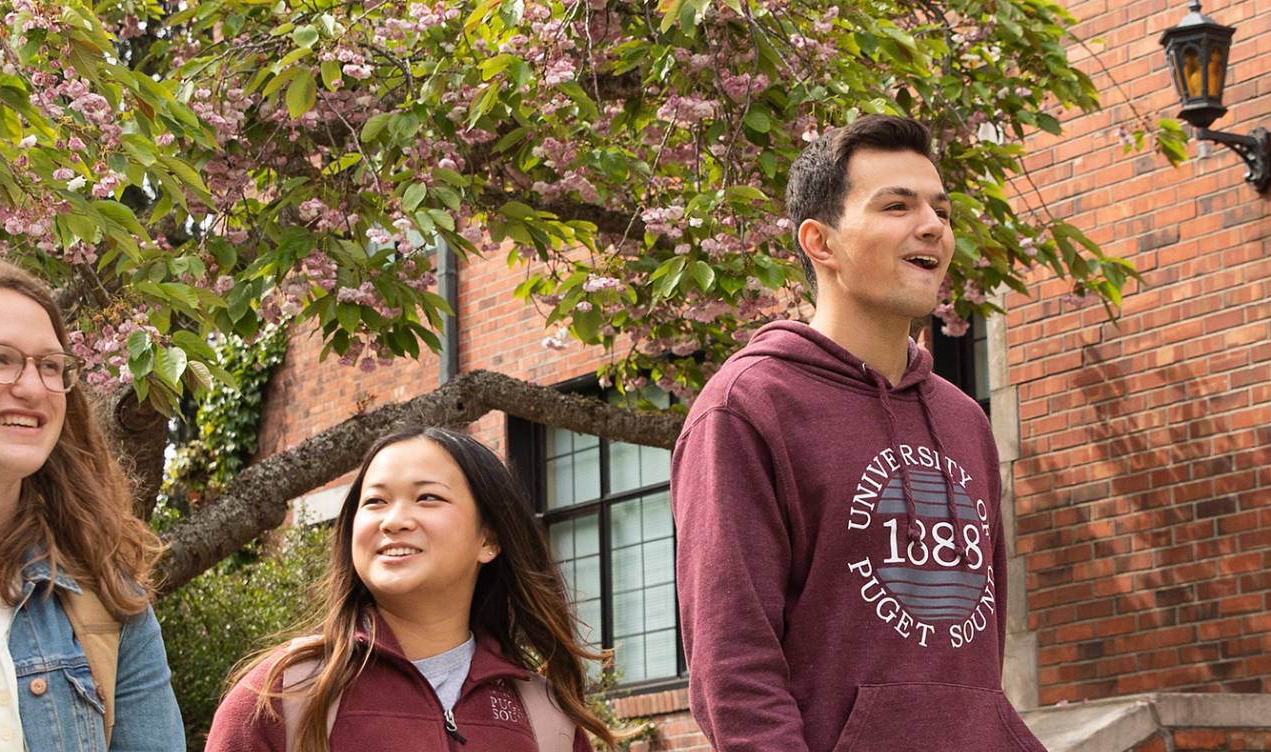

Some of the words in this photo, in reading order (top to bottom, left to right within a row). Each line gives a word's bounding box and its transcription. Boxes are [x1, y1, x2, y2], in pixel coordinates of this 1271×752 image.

[848, 444, 972, 530] UNIVERSITY
[883, 518, 983, 570] 1888
[848, 557, 935, 647] PUGET
